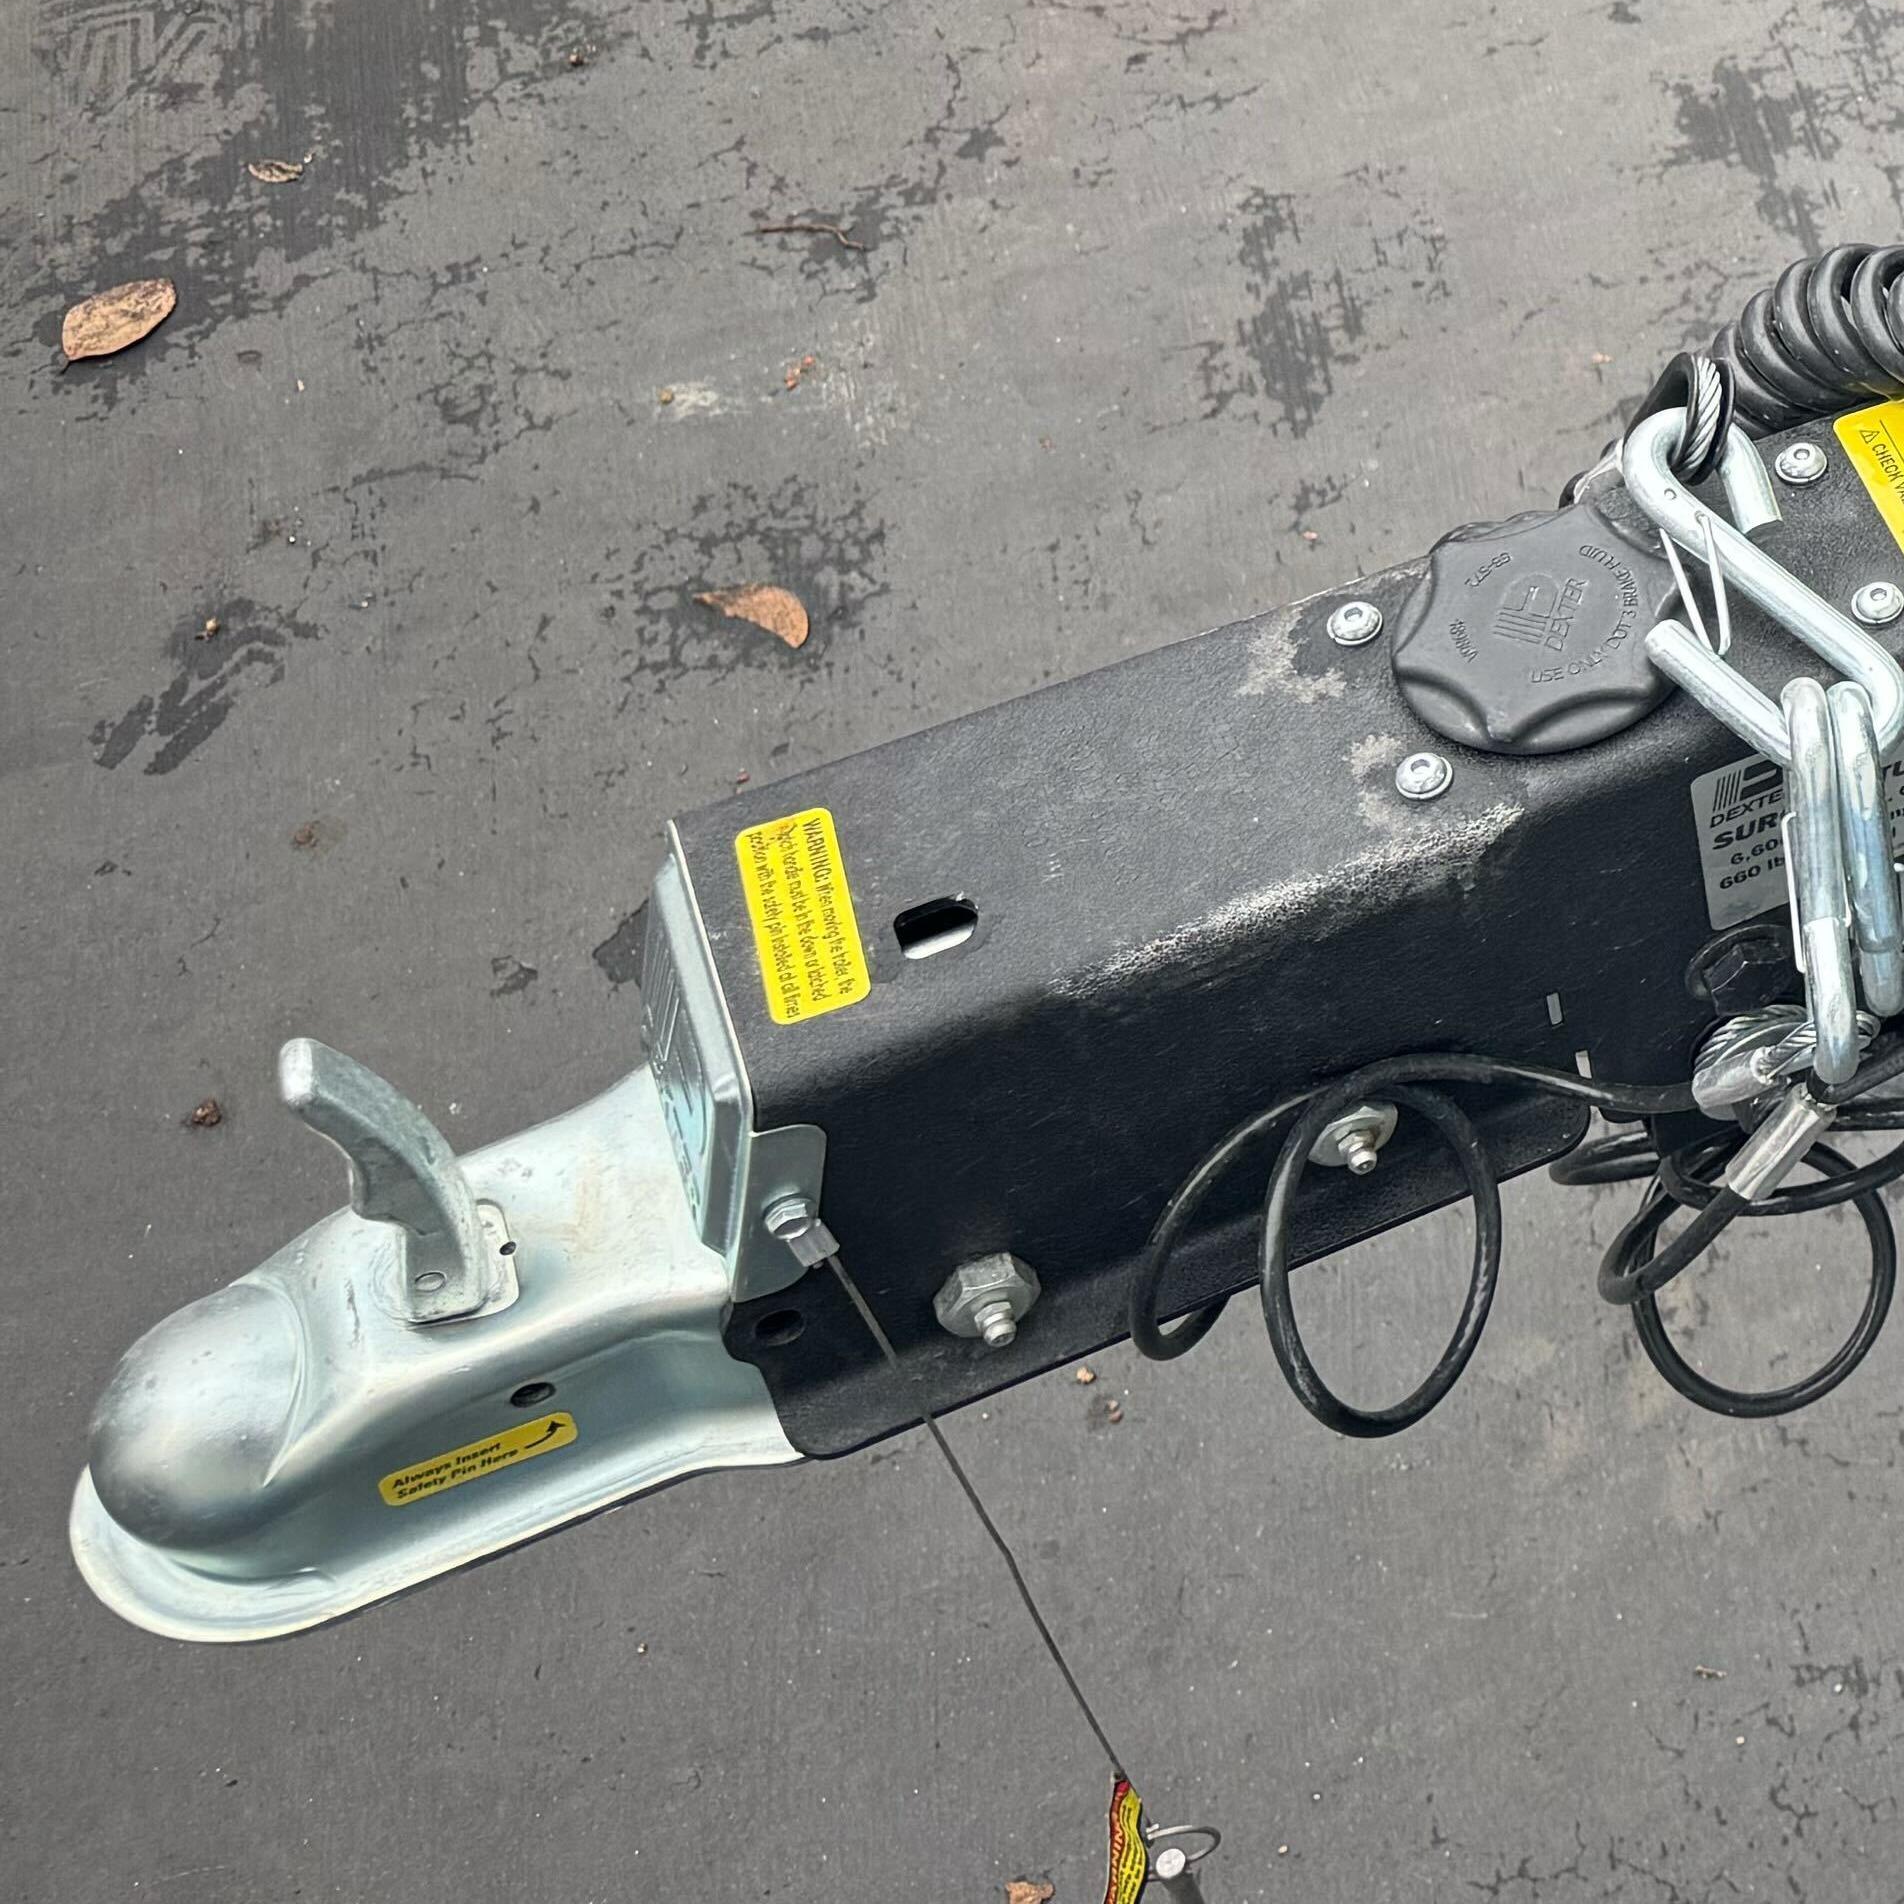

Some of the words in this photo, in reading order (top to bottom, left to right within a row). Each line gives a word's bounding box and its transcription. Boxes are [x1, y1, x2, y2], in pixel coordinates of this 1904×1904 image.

[1871, 443, 1903, 482] CHECK
[1578, 544, 1621, 570] FLUID
[1616, 567, 1639, 607] BRAKE
[1544, 576, 1589, 652] DEXTER
[1606, 618, 1632, 650] DOT
[1531, 666, 1565, 684] USE
[1567, 647, 1606, 675] ONLY
[1709, 789, 1784, 829] DEXTE
[1712, 810, 1788, 850] SUR
[803, 818, 831, 882] WARNING:
[1730, 838, 1785, 865] 6,60
[1719, 865, 1762, 890] 660
[1767, 856, 1786, 871] lb
[392, 1462, 452, 1489] Always
[455, 1442, 501, 1466] Insert
[396, 1476, 447, 1499] Safety
[450, 1463, 477, 1479] Pin
[479, 1448, 519, 1469] Here
